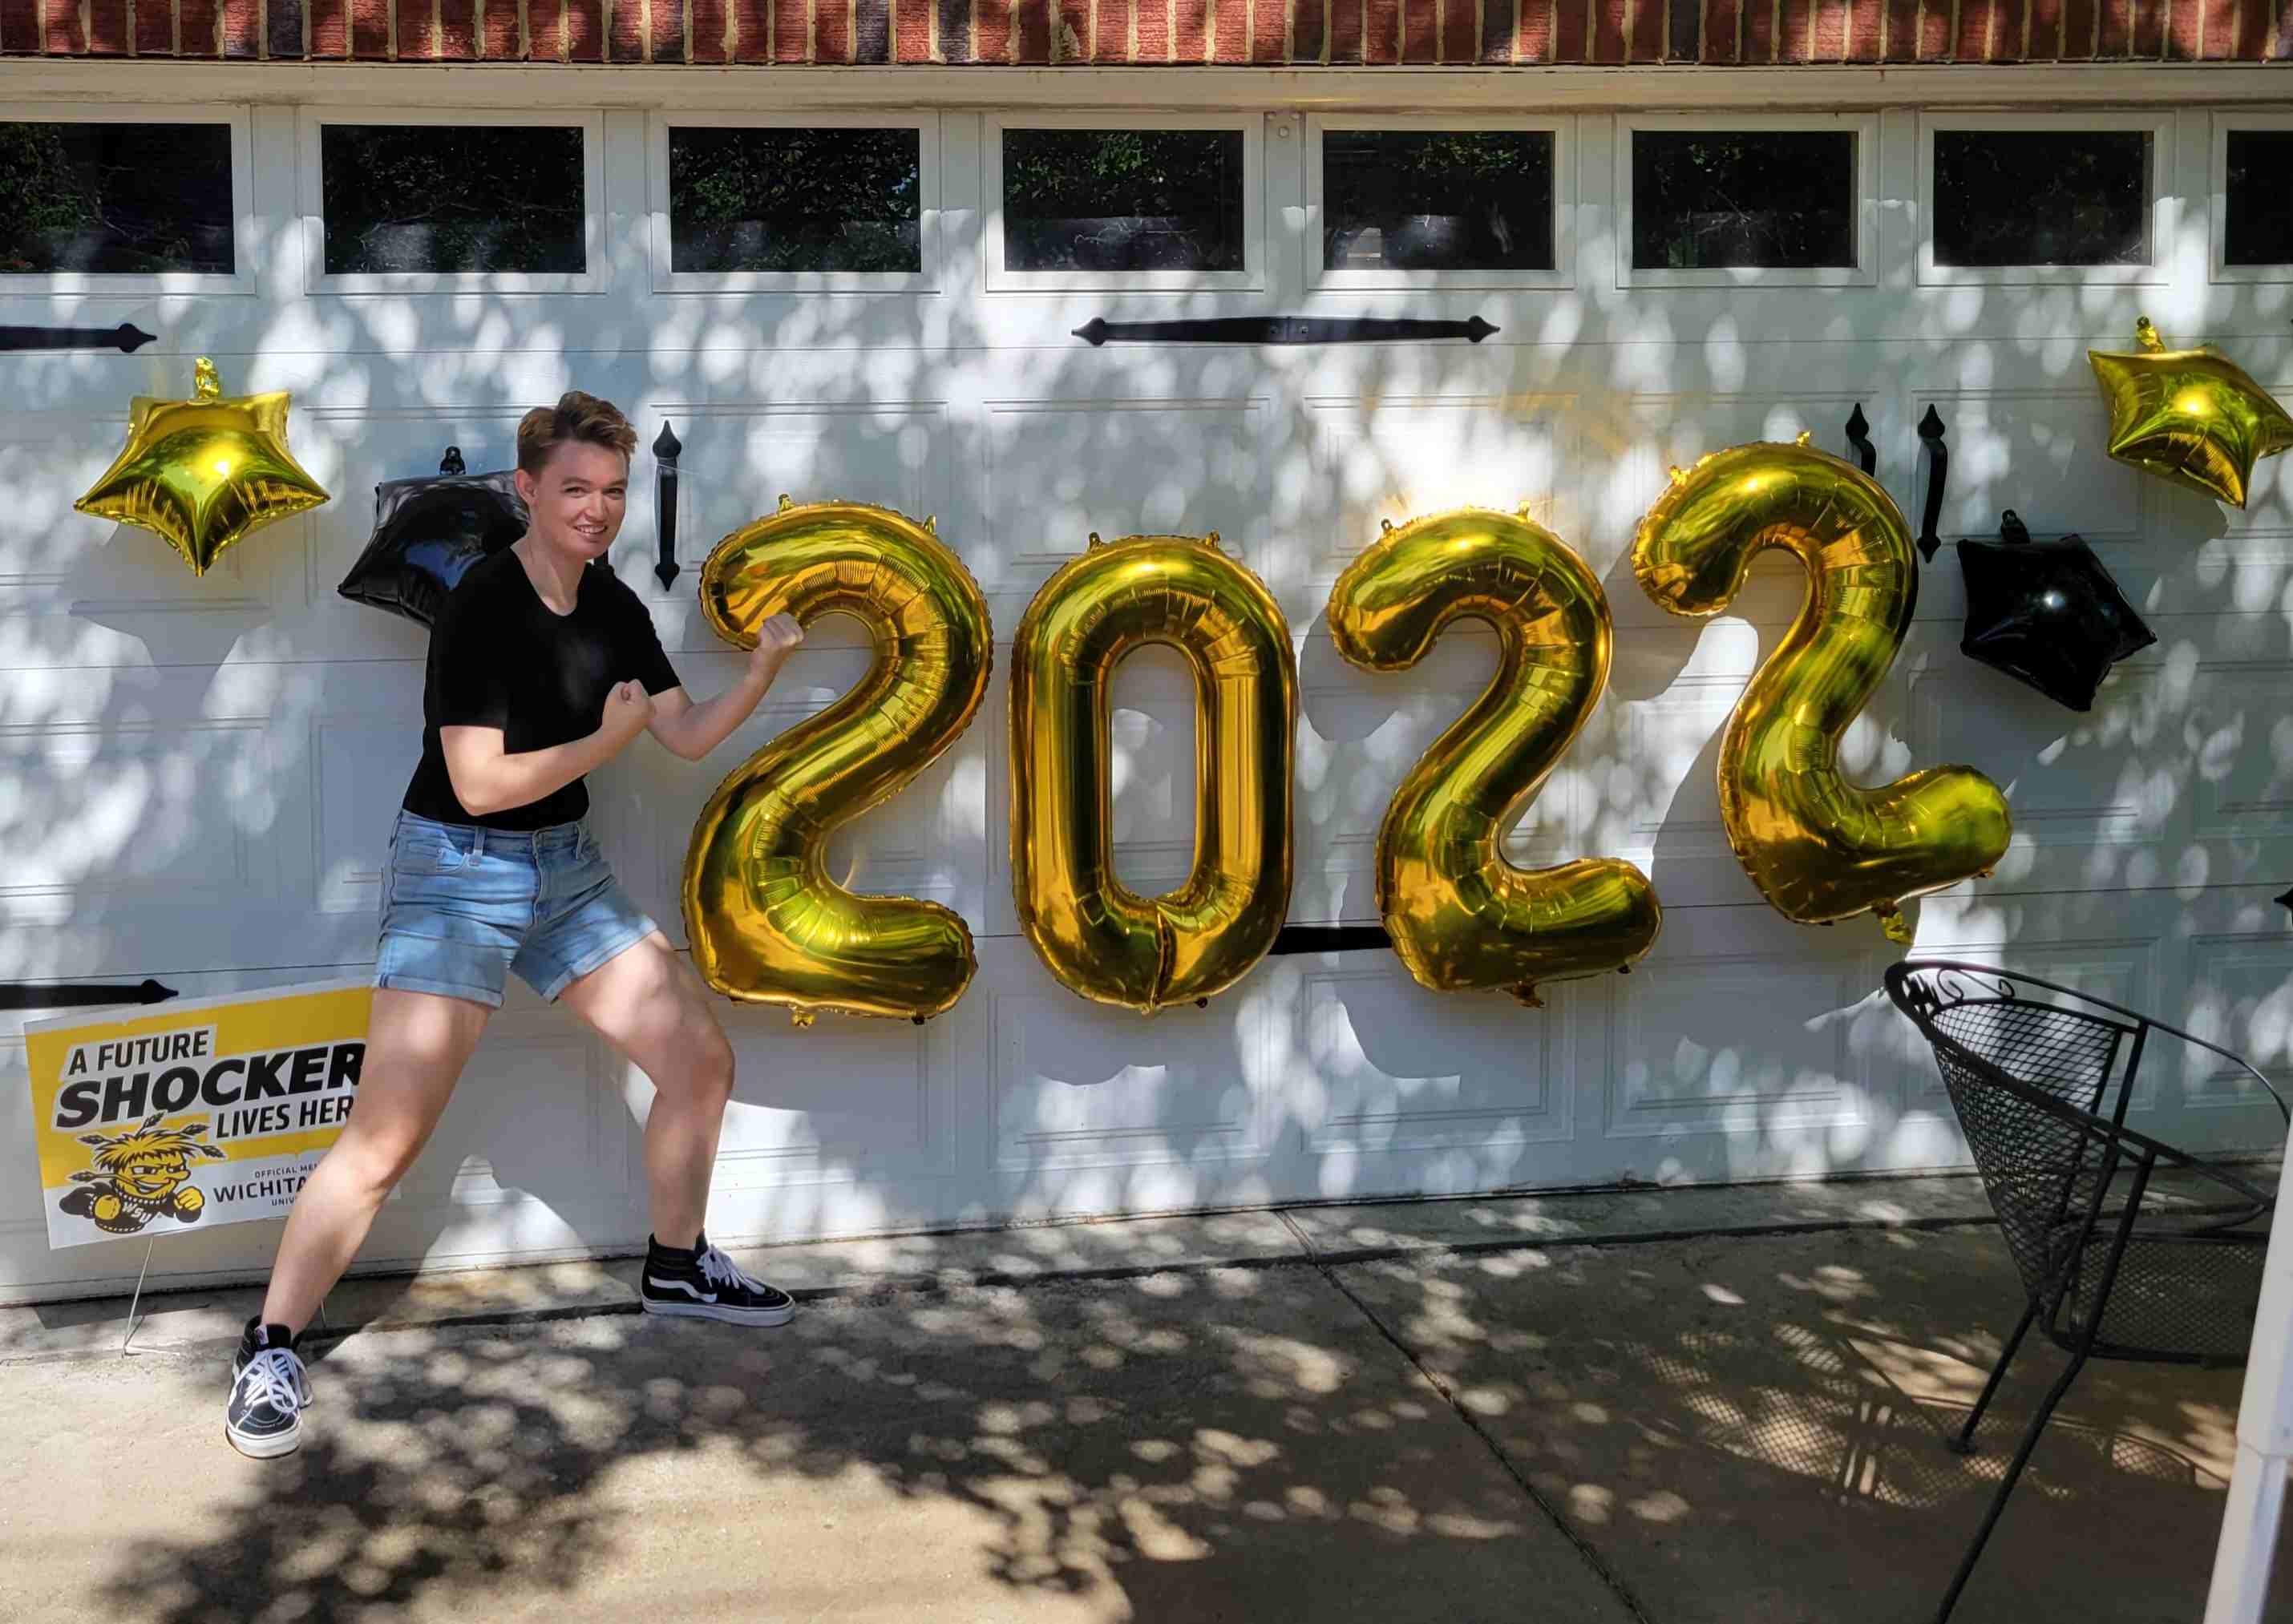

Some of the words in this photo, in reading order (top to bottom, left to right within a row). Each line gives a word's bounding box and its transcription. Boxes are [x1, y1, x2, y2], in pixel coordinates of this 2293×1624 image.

[682, 439, 2013, 1024] 2022
[68, 1047, 87, 1076] A
[97, 1029, 209, 1072] FUTURE
[56, 1042, 366, 1128] SHOCKER
[216, 1104, 290, 1138] LIVES
[299, 1095, 354, 1127] HER
[254, 1166, 297, 1178] OFFICIAL
[122, 1202, 152, 1224] WSU
